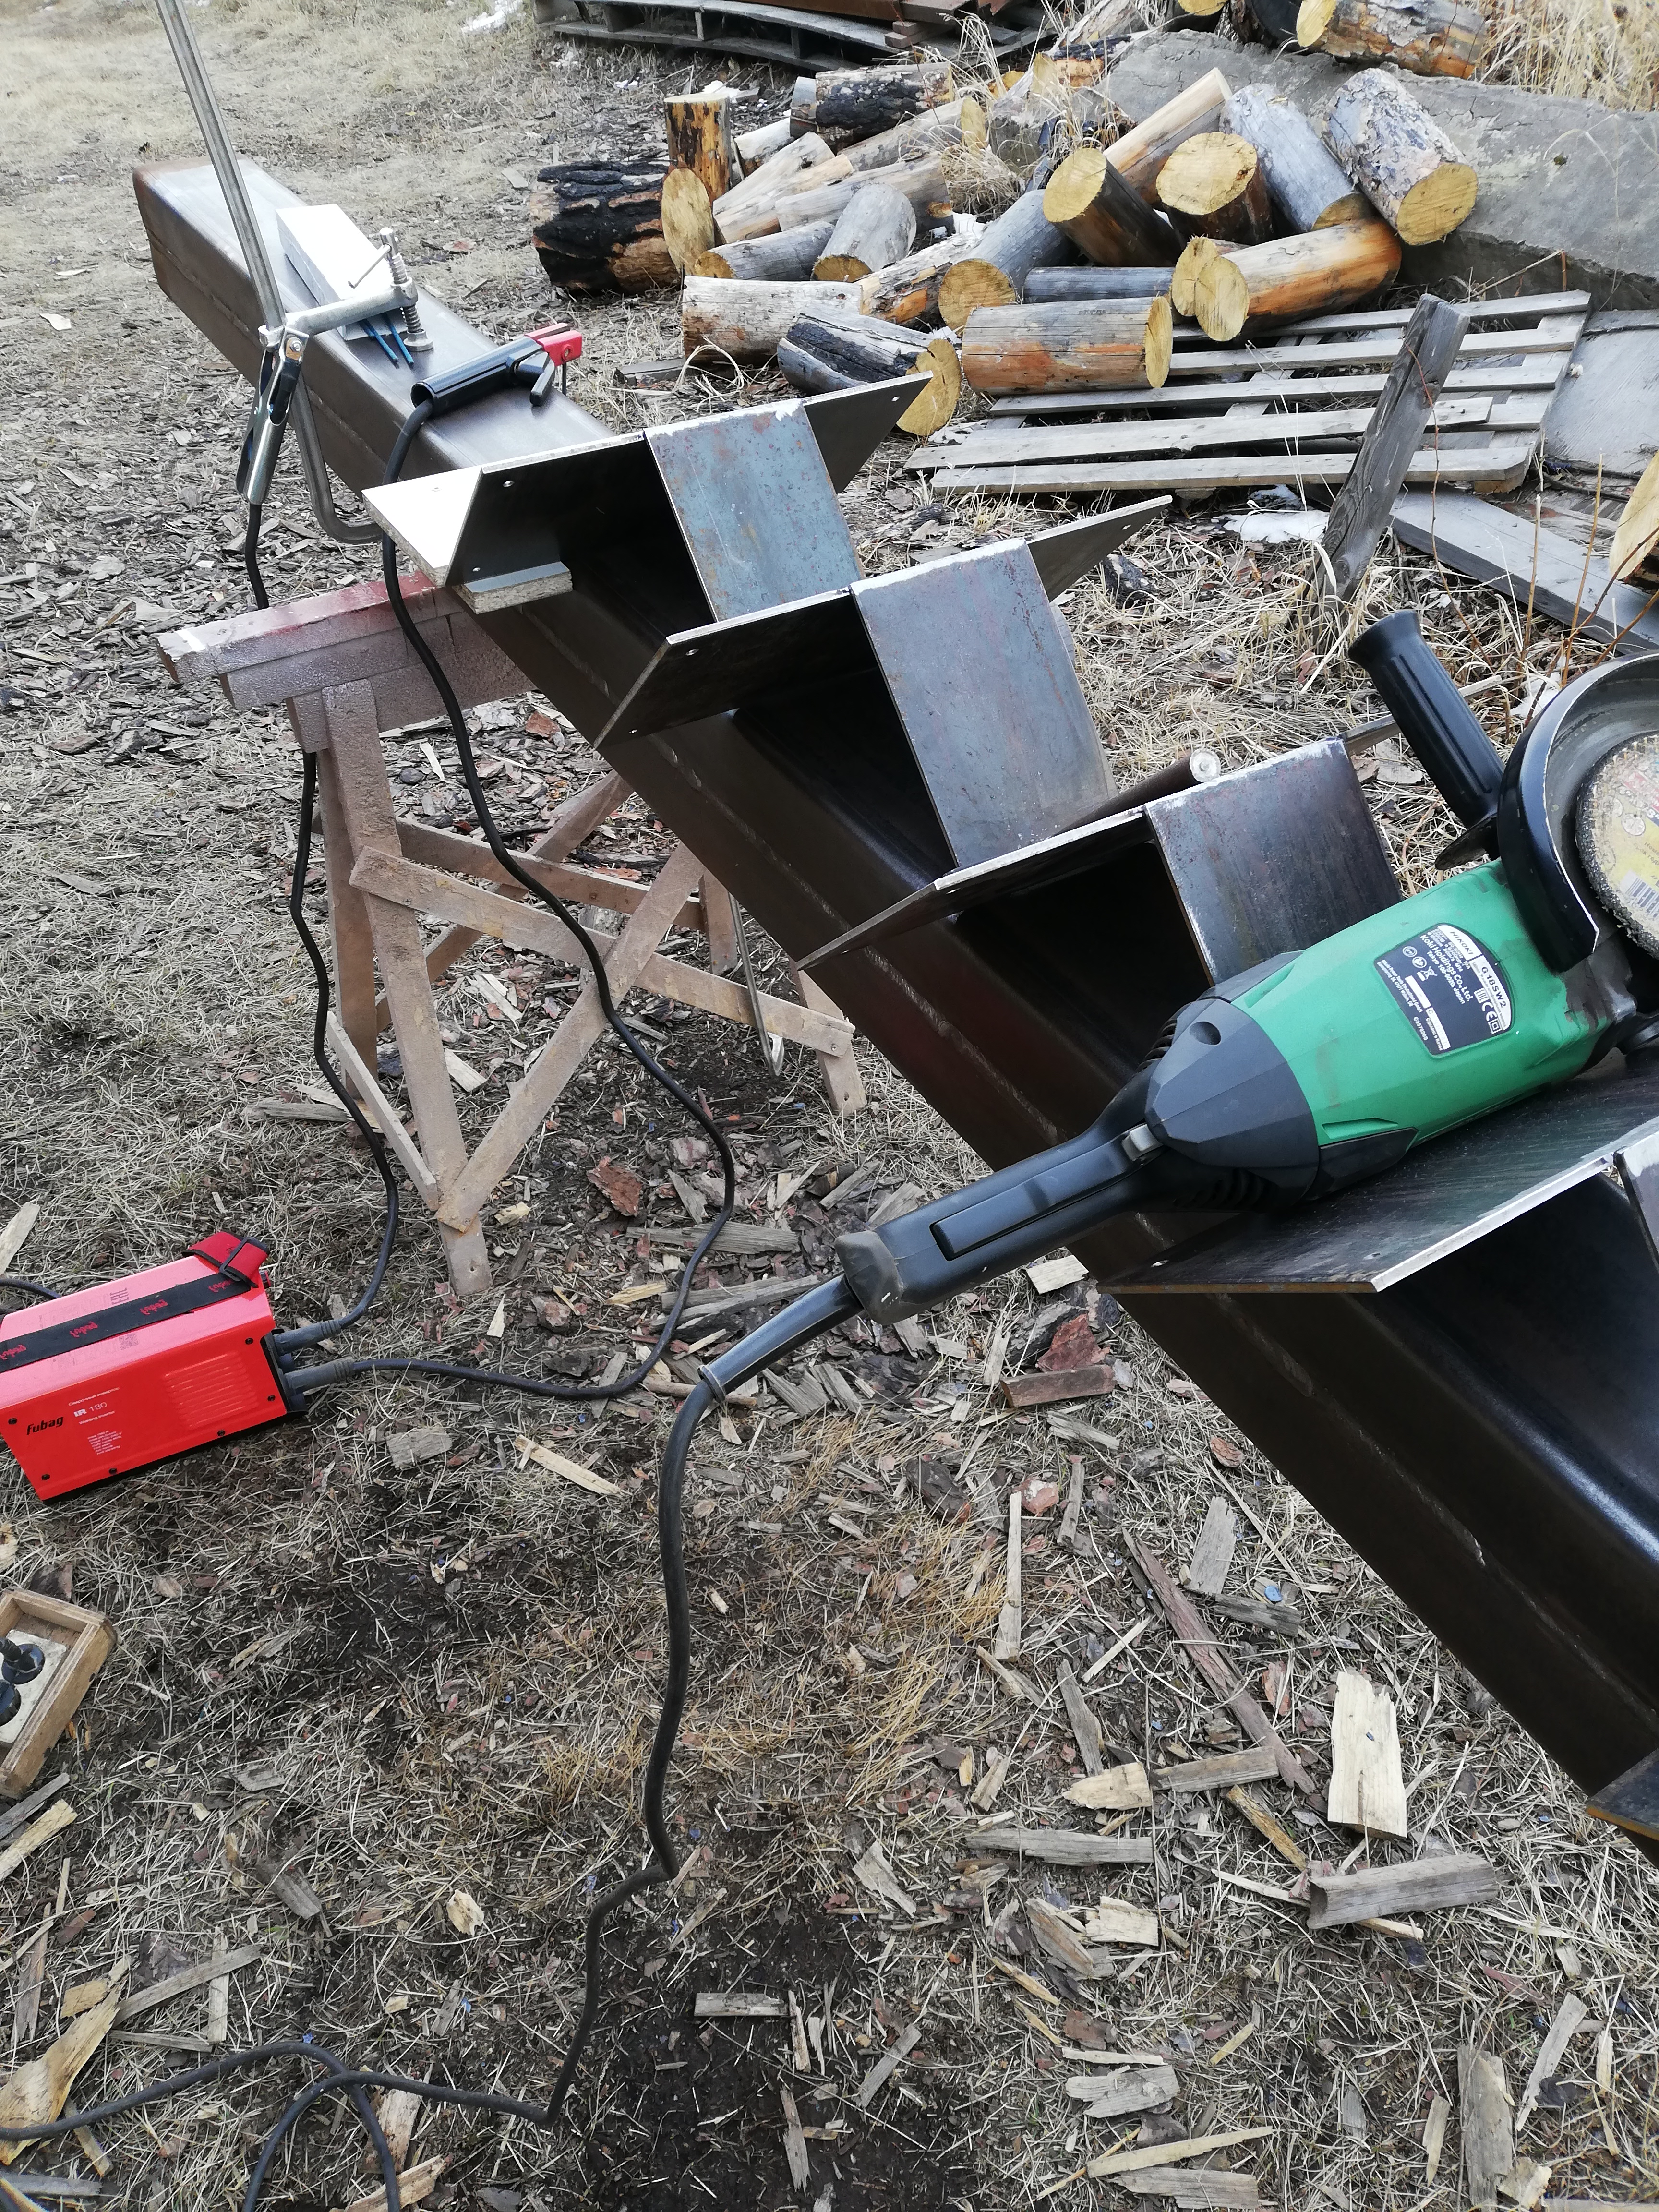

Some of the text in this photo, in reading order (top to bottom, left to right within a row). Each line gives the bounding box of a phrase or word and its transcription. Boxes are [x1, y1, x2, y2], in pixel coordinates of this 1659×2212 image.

[1420, 934, 1437, 948] Koki
[1432, 947, 1456, 975] Holdings
[1427, 950, 1440, 964] Tokyo
[1453, 988, 1465, 1004] Japan
[73, 1402, 108, 1417] IR 180
